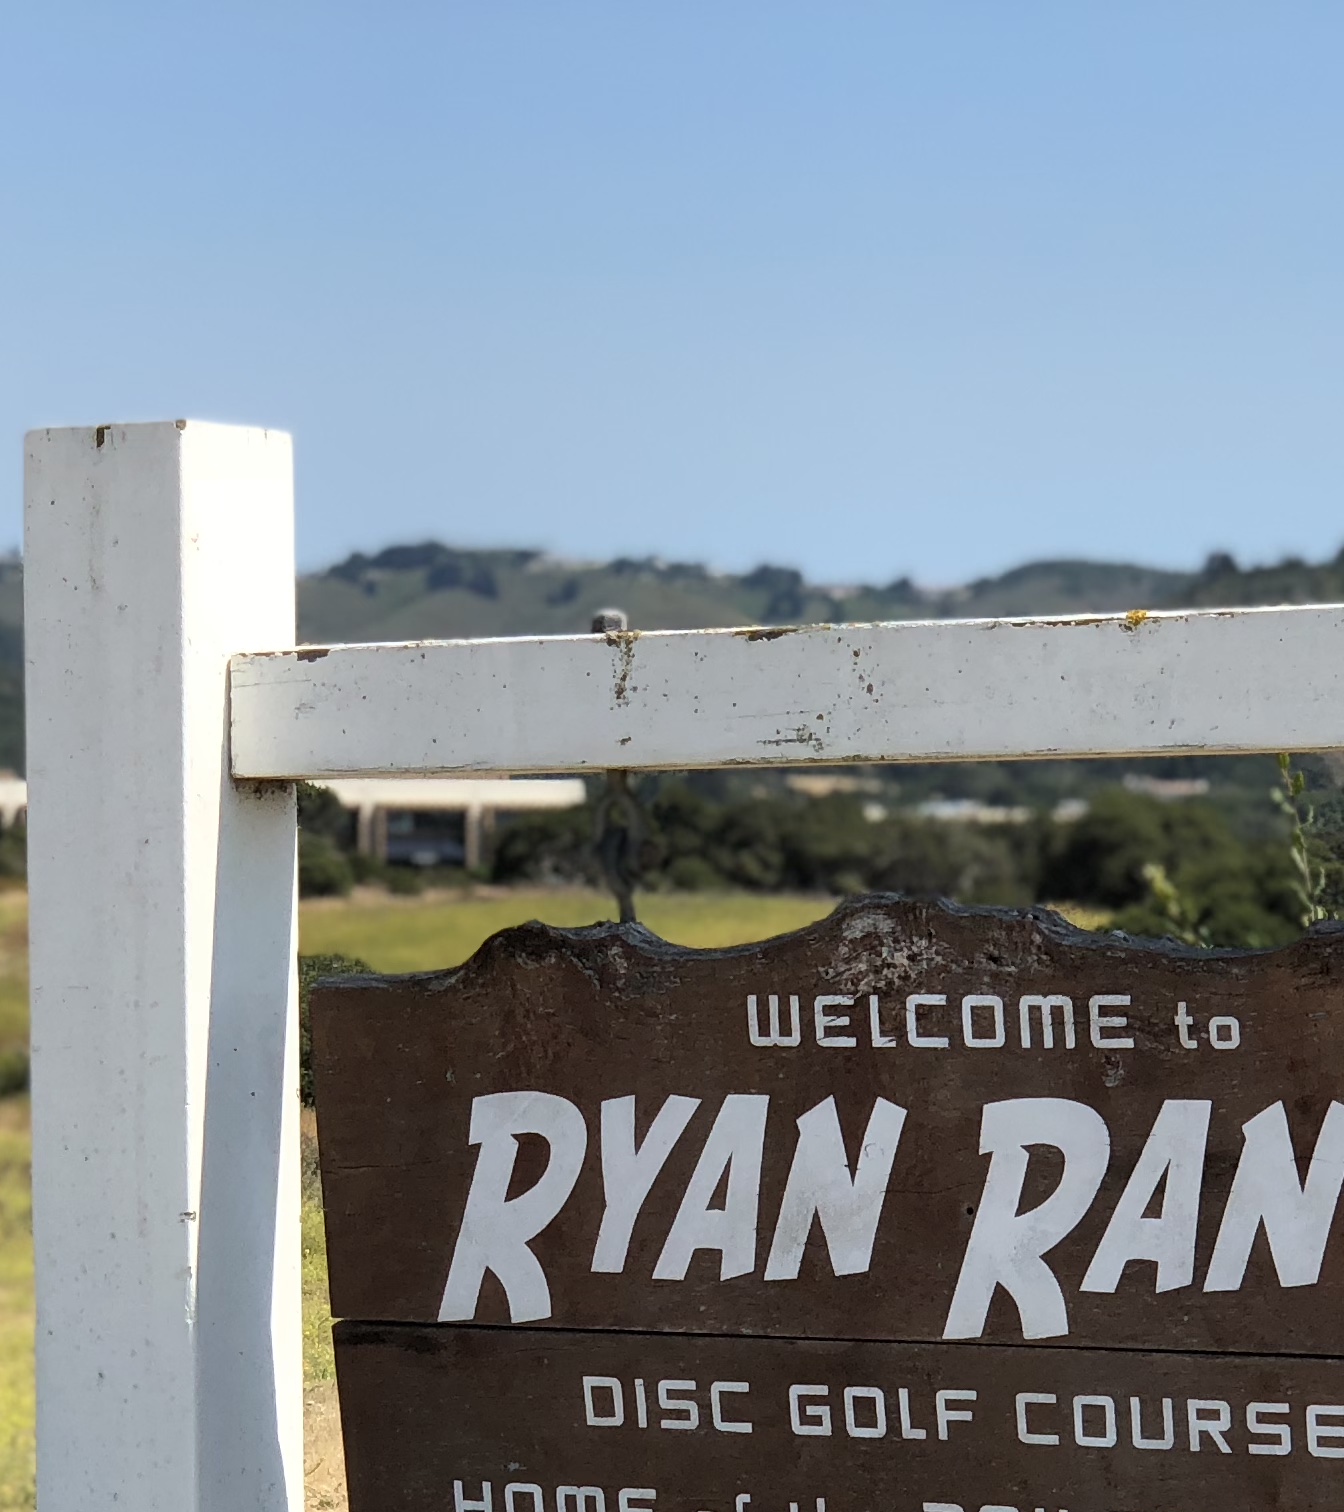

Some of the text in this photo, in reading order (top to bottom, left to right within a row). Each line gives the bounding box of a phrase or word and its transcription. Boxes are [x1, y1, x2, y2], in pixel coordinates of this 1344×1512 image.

[747, 994, 1240, 1049] WELCOME to
[437, 1091, 907, 1323] RYAN
[583, 1376, 752, 1433] DISC
[789, 1385, 976, 1440] GOLF
